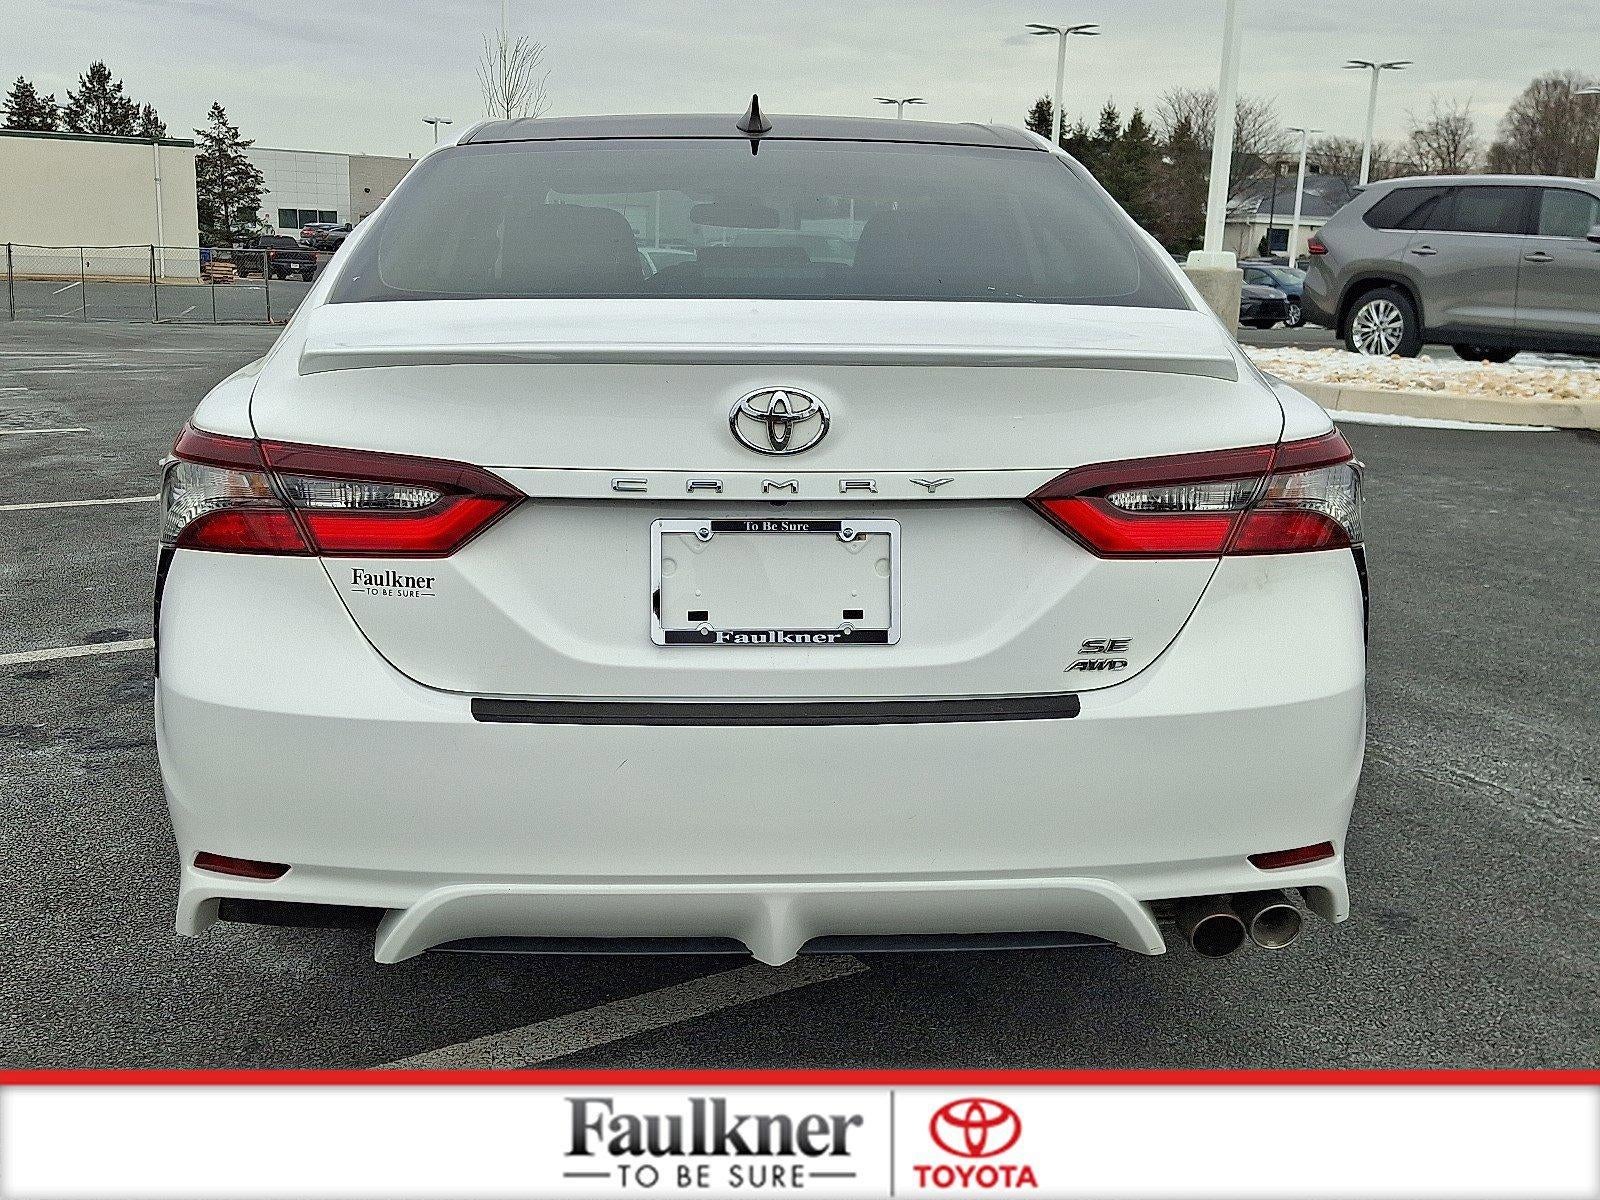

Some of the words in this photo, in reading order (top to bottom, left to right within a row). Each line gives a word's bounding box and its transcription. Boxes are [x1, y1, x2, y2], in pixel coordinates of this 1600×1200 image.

[610, 477, 955, 494] CAMRY
[743, 520, 758, 532] To
[762, 520, 777, 532] Be
[779, 520, 810, 532] Sure
[350, 567, 436, 590] Faulkner
[366, 587, 379, 596] TO
[382, 588, 393, 597] BE
[397, 589, 420, 598] SURE
[713, 630, 842, 644] Faulkner
[1077, 636, 1134, 654] SE
[1063, 658, 1128, 673] AWD
